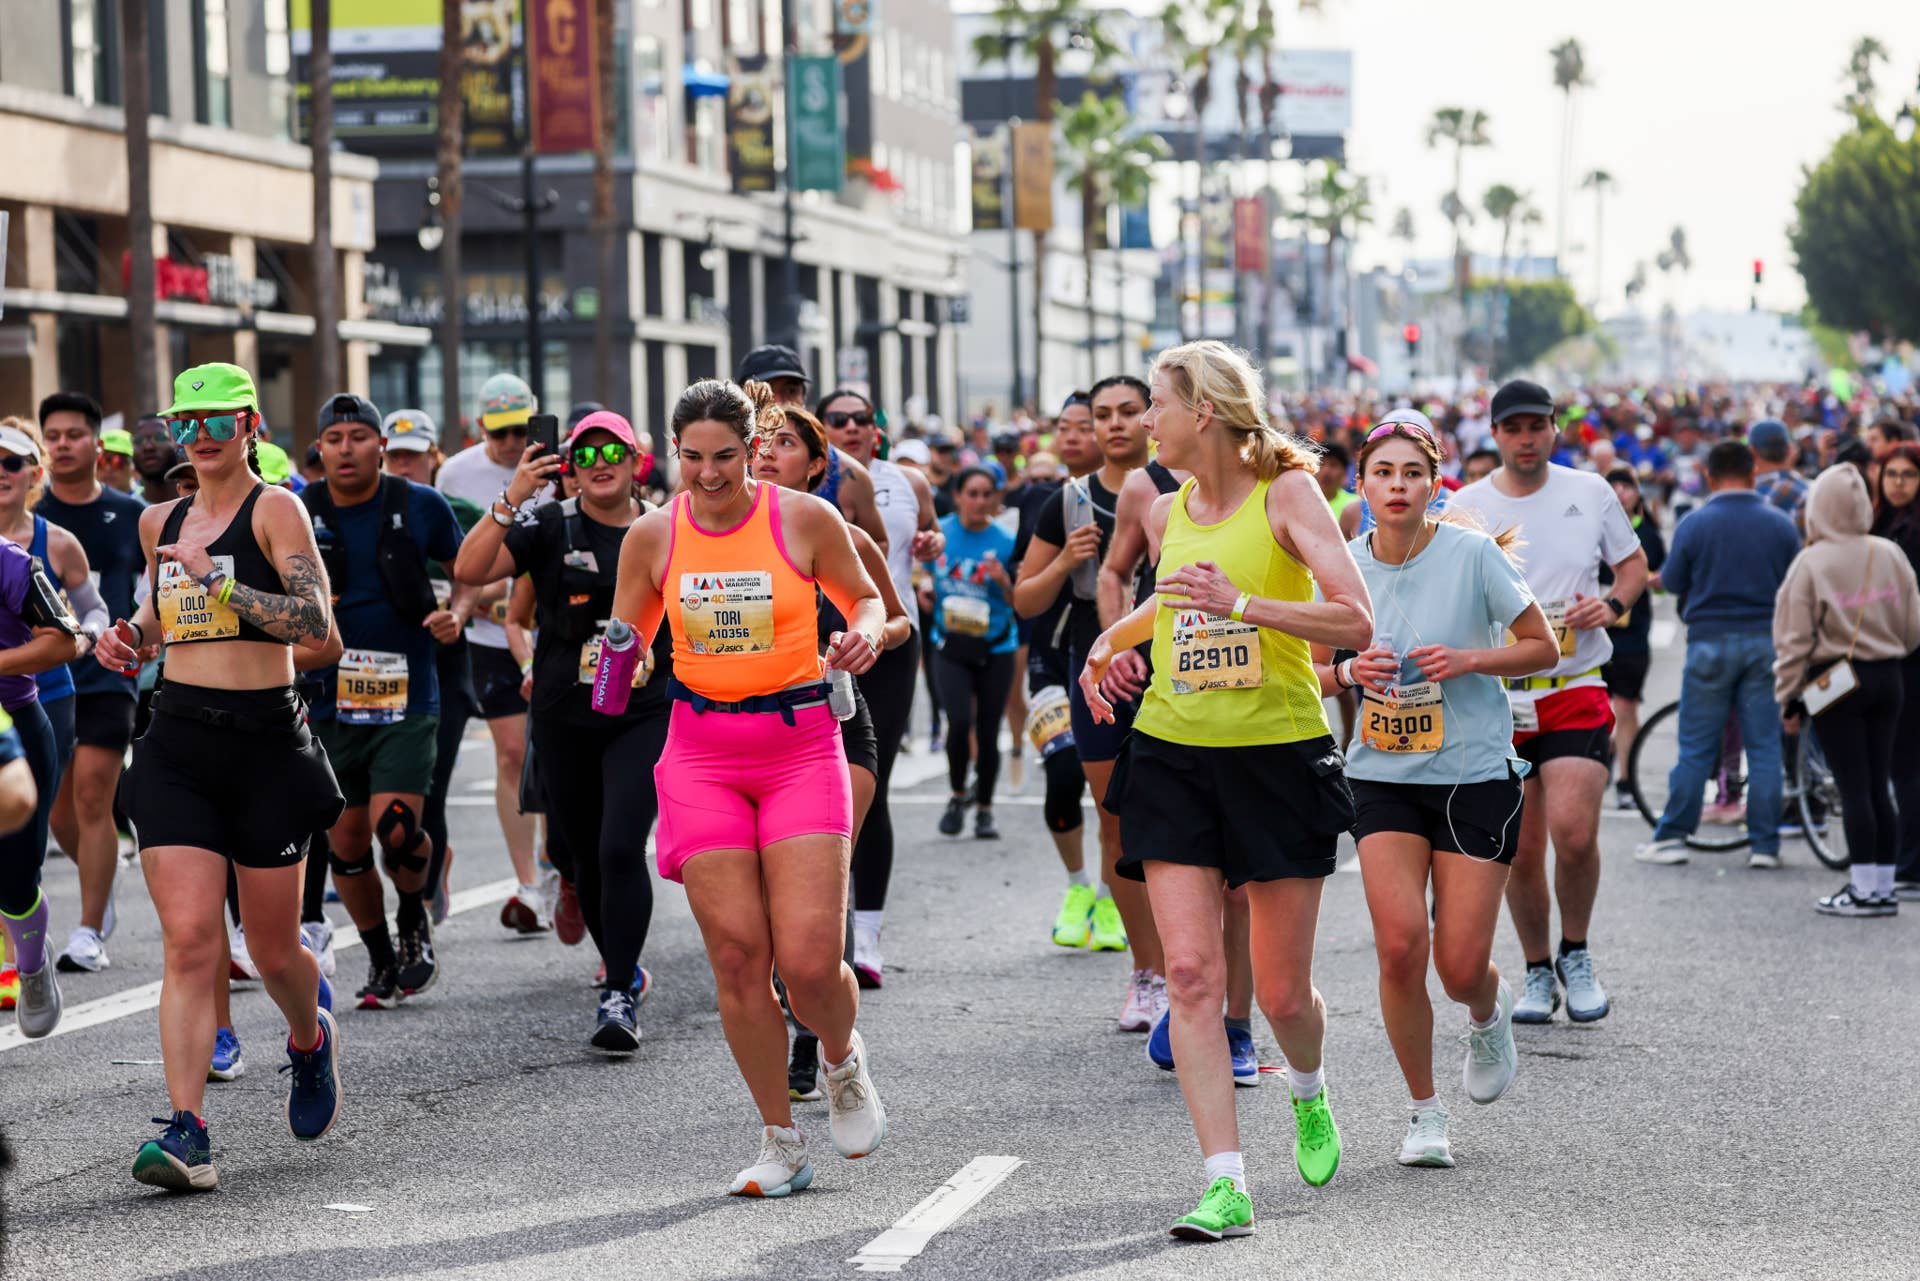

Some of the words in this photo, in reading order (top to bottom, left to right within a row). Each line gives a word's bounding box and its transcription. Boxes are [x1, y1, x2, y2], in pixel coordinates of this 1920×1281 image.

[180, 595, 205, 612] LOLO
[711, 593, 726, 604] 40
[176, 612, 213, 625] A10907
[713, 610, 741, 626] TORI
[708, 628, 750, 640] A10356
[1194, 629, 1209, 640] 40
[1178, 644, 1249, 673] B2910
[345, 678, 399, 696] 18539
[597, 656, 611, 707] NATHAN
[1385, 701, 1398, 711] 40
[1370, 711, 1433, 736] 21300
